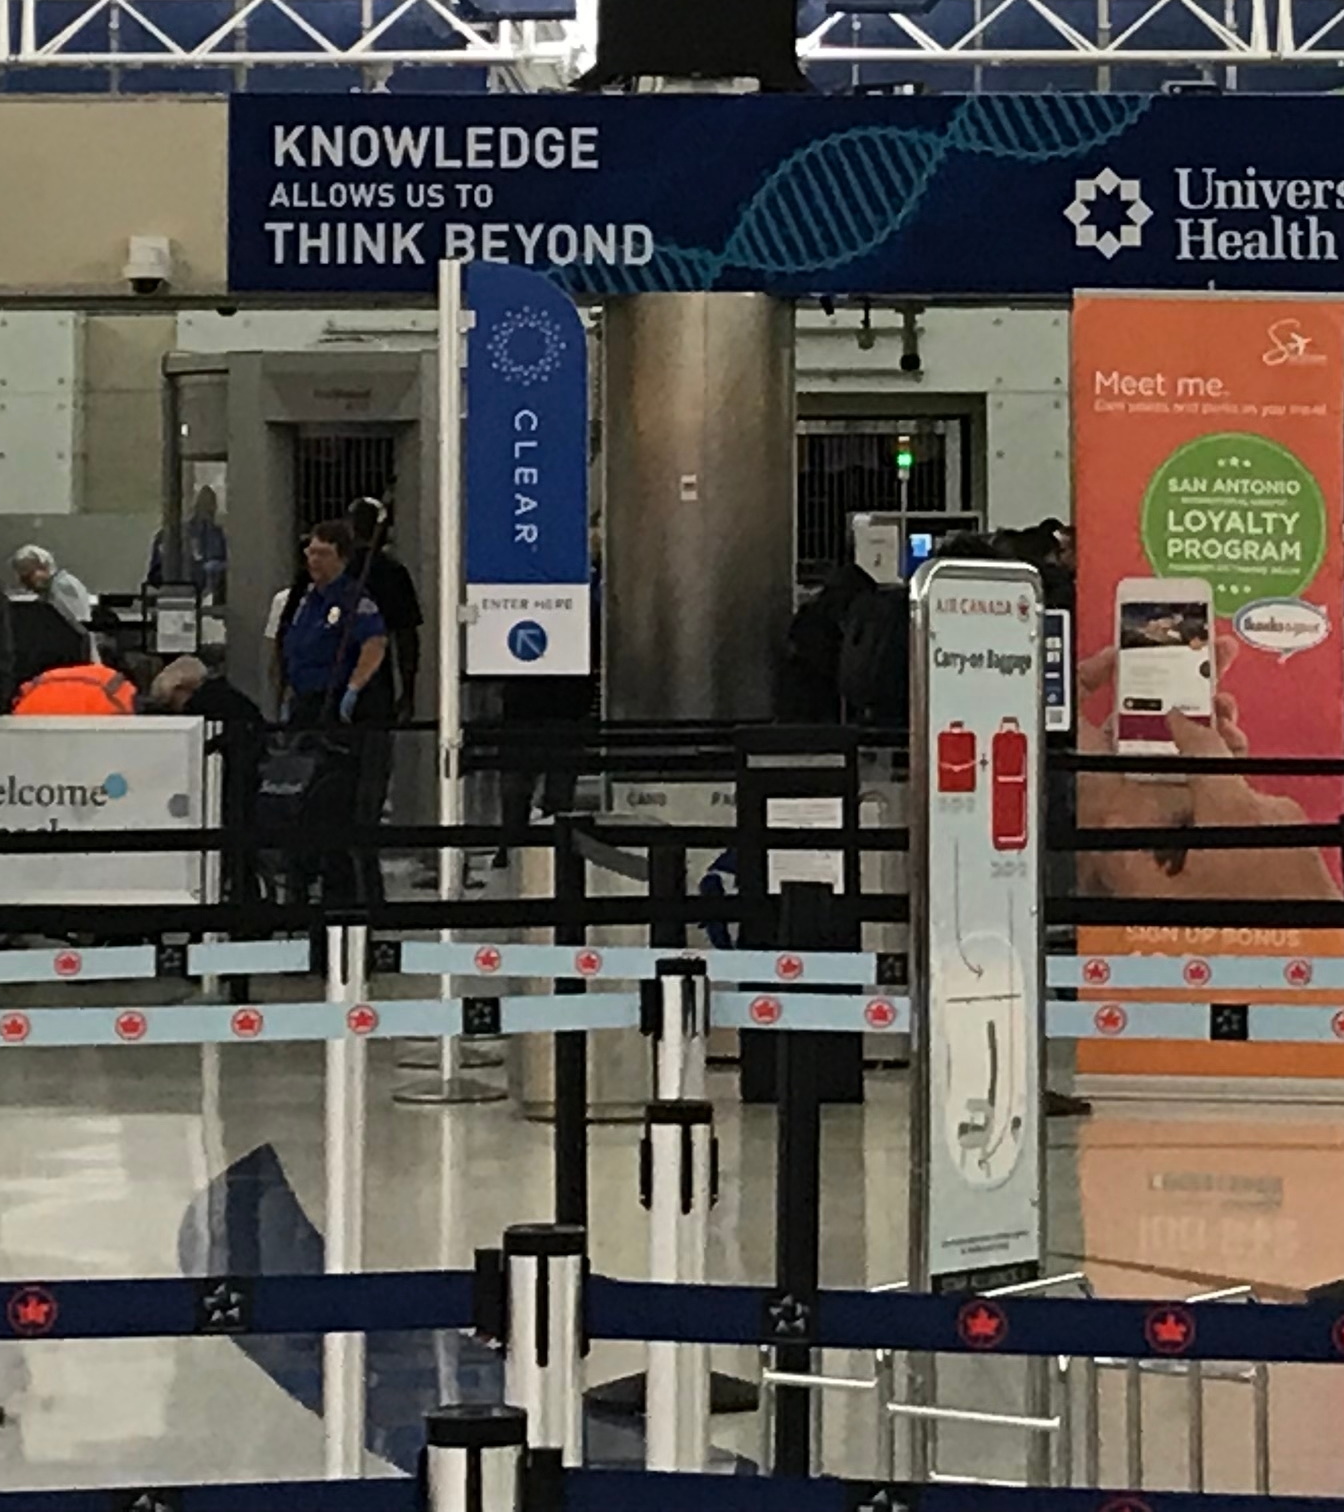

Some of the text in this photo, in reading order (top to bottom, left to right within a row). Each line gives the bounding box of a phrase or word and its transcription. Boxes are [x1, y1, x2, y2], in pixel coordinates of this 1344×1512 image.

[274, 125, 599, 169] KNOWLEDGE
[269, 183, 494, 208] ALLOWS US TO
[264, 222, 654, 266] THINK BEYOND
[1175, 216, 1339, 261] Health
[1094, 371, 1166, 396] Meet
[514, 410, 539, 543] CLEAR
[1168, 476, 1301, 495] SAN ANTONIO
[1168, 509, 1300, 534] LOYALTY
[1167, 538, 1302, 562] PROGRAM
[960, 598, 1012, 617] CANADA
[934, 647, 984, 675] Carry-on
